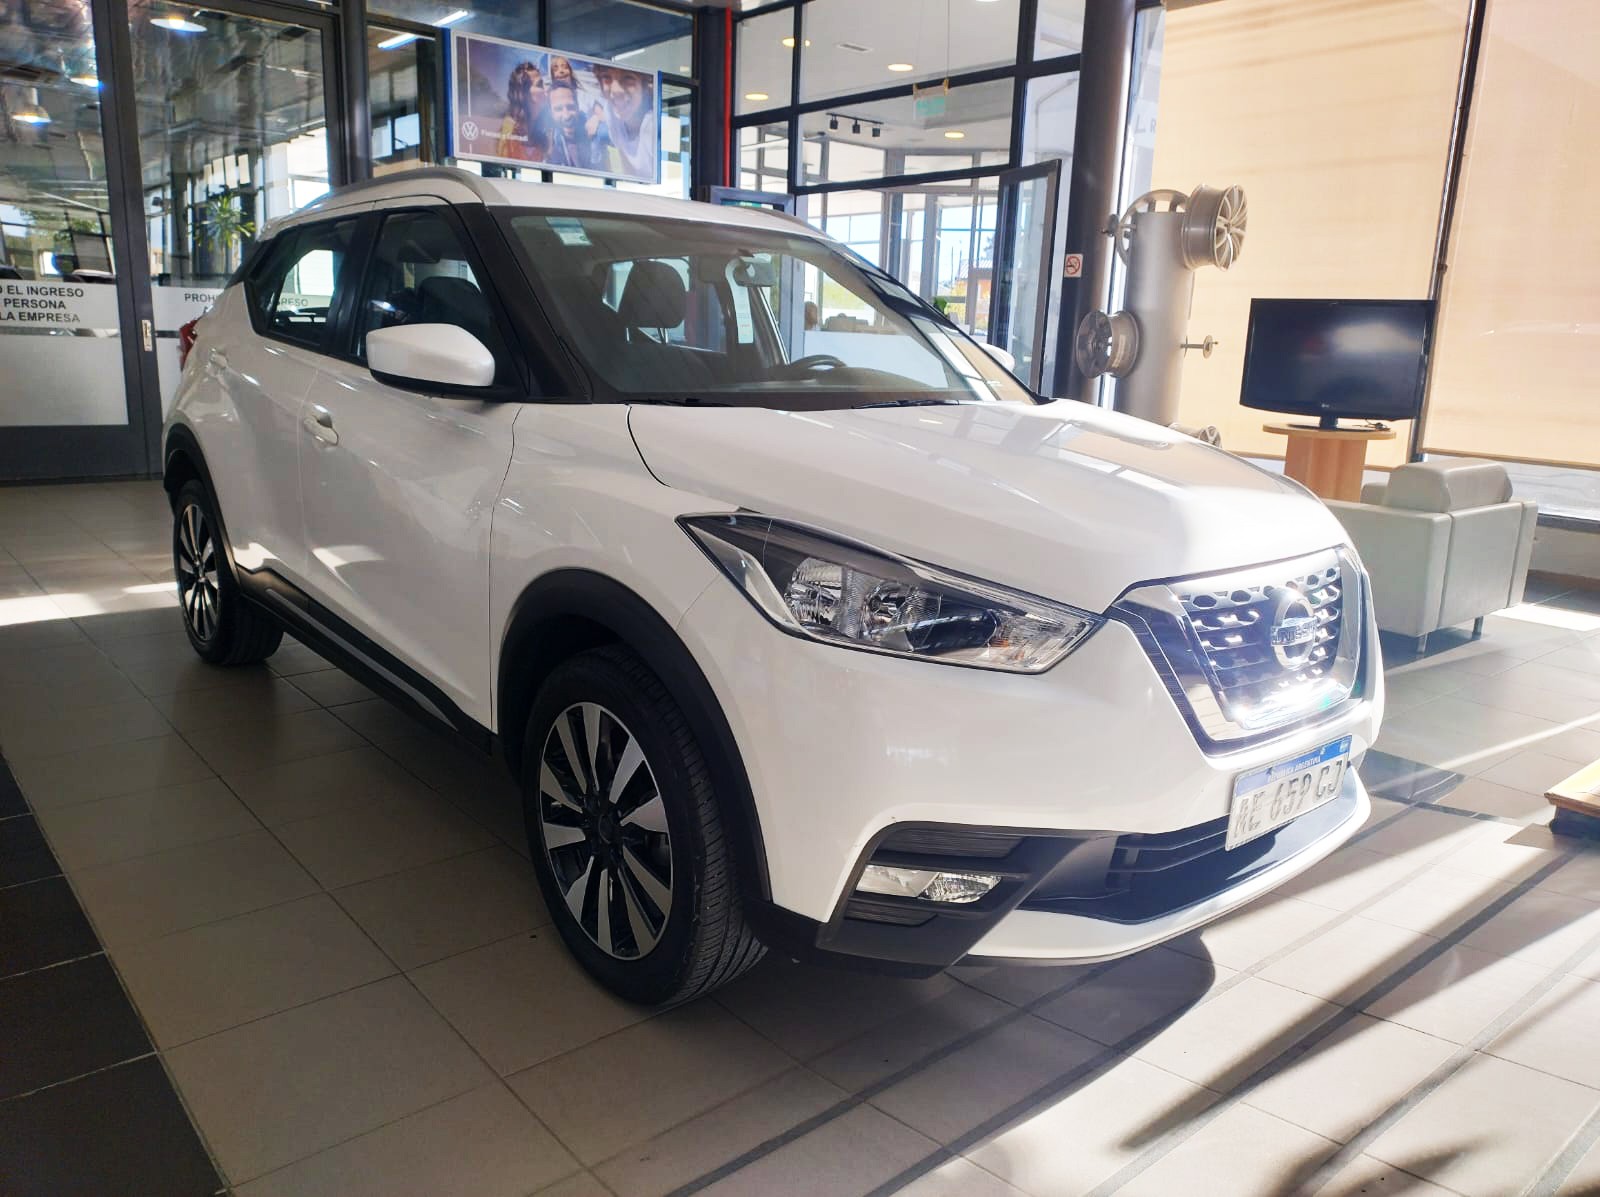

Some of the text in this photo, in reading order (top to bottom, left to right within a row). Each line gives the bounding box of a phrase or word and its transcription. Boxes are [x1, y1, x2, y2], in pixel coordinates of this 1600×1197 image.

[7, 285, 23, 295] EL
[26, 286, 84, 298] INGRESO
[3, 298, 66, 310] PERSONA
[184, 293, 216, 303] PROH
[279, 297, 309, 307] RESO
[0, 311, 81, 323] LA EMPRESA
[1233, 790, 1265, 839] AE
[1314, 759, 1343, 798] CJ
